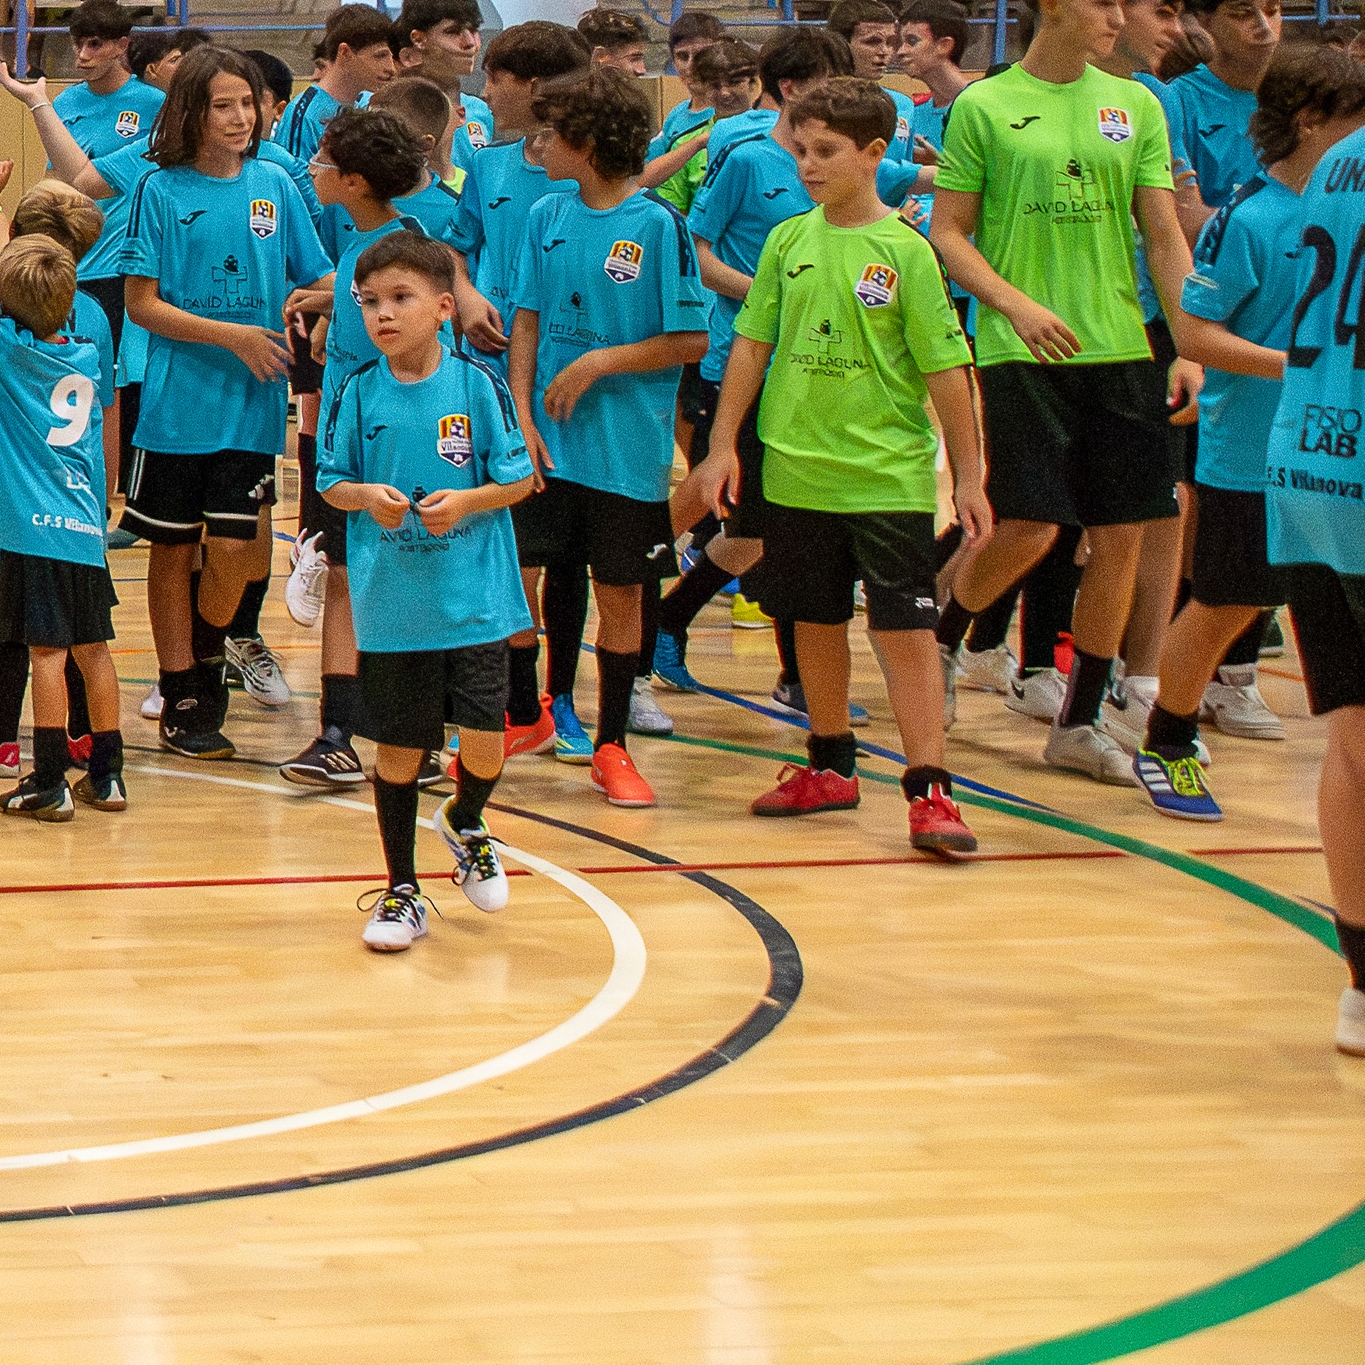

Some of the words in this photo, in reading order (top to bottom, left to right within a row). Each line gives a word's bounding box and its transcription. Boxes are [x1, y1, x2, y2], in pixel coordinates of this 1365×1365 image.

[1288, 225, 1365, 370] 24
[46, 373, 95, 447] 9
[1299, 428, 1357, 459] LAB
[32, 513, 61, 528] C.F.S
